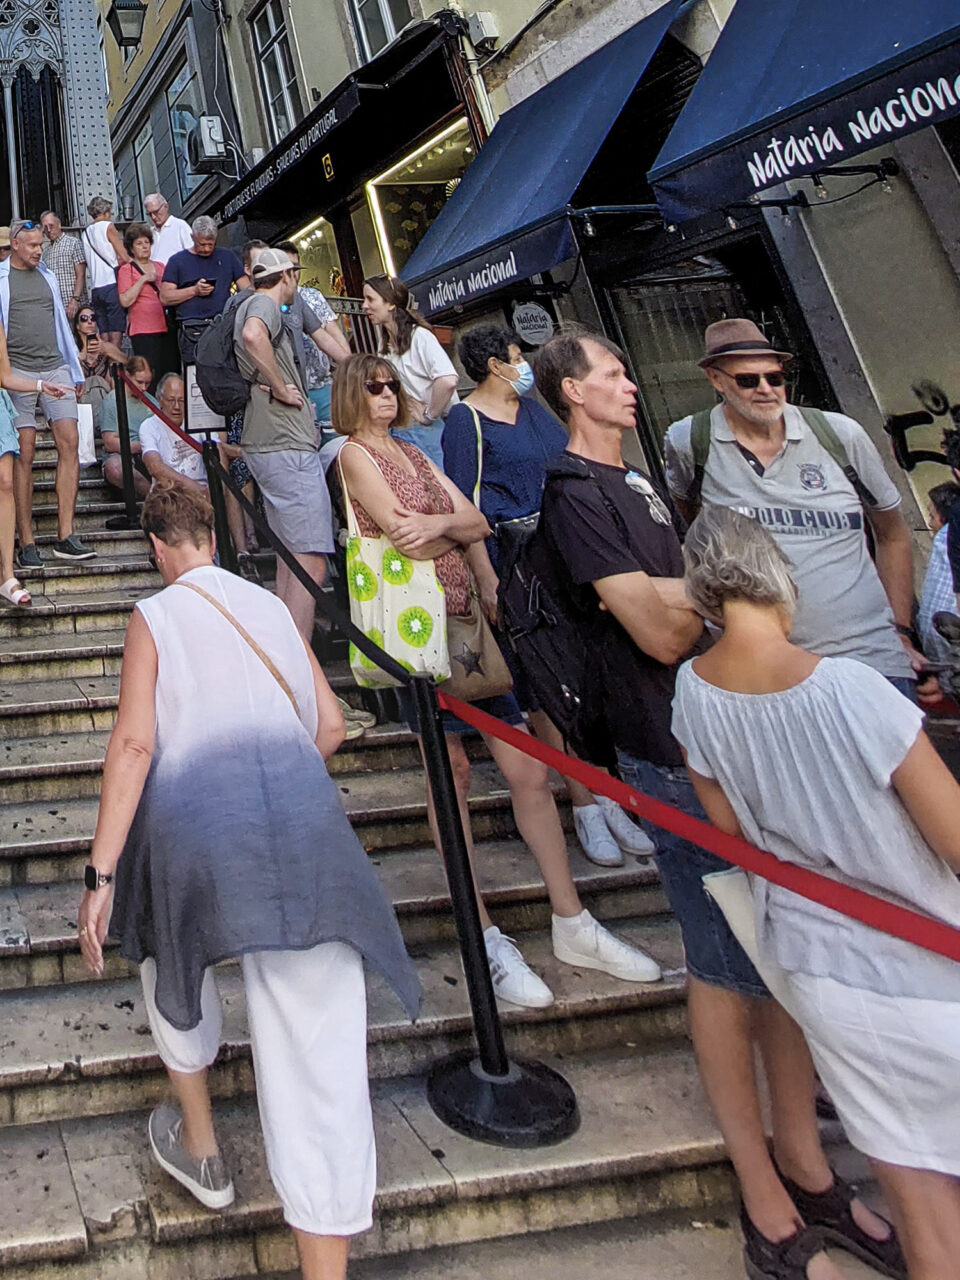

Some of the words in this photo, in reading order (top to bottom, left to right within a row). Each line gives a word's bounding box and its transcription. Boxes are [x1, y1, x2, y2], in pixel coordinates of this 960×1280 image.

[299, 137, 308, 153] DU
[307, 107, 338, 147] PORTUGAL
[747, 125, 844, 187] Nataria
[848, 77, 960, 144] Nacion
[323, 156, 332, 176] 6
[428, 276, 466, 311] Nataria
[467, 250, 518, 293] Nacional
[516, 311, 548, 325] Nataria
[801, 509, 851, 529] CLUB
